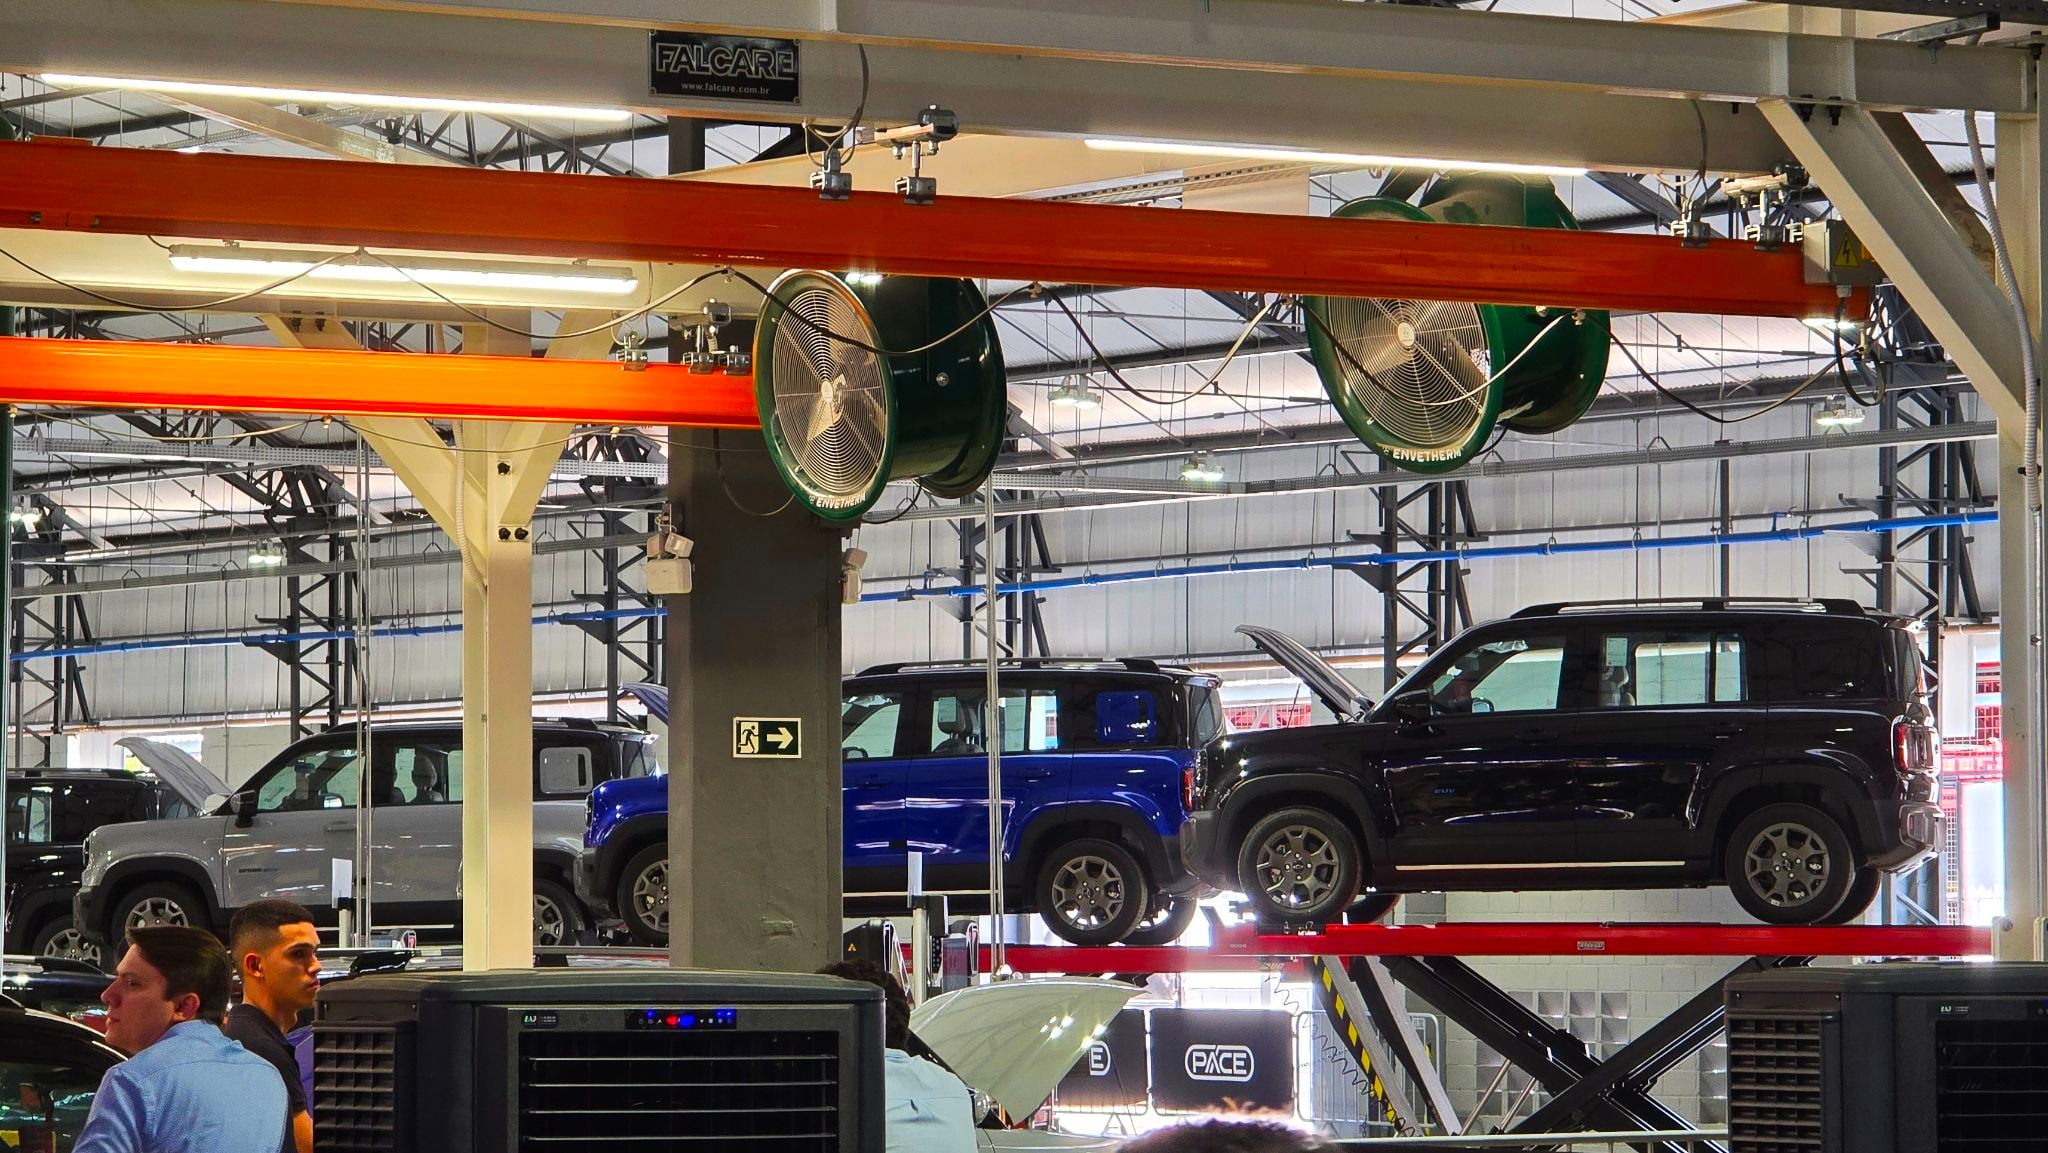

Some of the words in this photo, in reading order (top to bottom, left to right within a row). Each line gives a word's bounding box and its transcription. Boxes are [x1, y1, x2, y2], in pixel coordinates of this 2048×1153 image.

[655, 42, 795, 81] FALCARE
[681, 82, 770, 96] www.falcare.com.br
[1392, 446, 1462, 463] ENVETHERM
[815, 491, 866, 509] ENVETHERM
[1191, 1050, 1248, 1076] PACE
